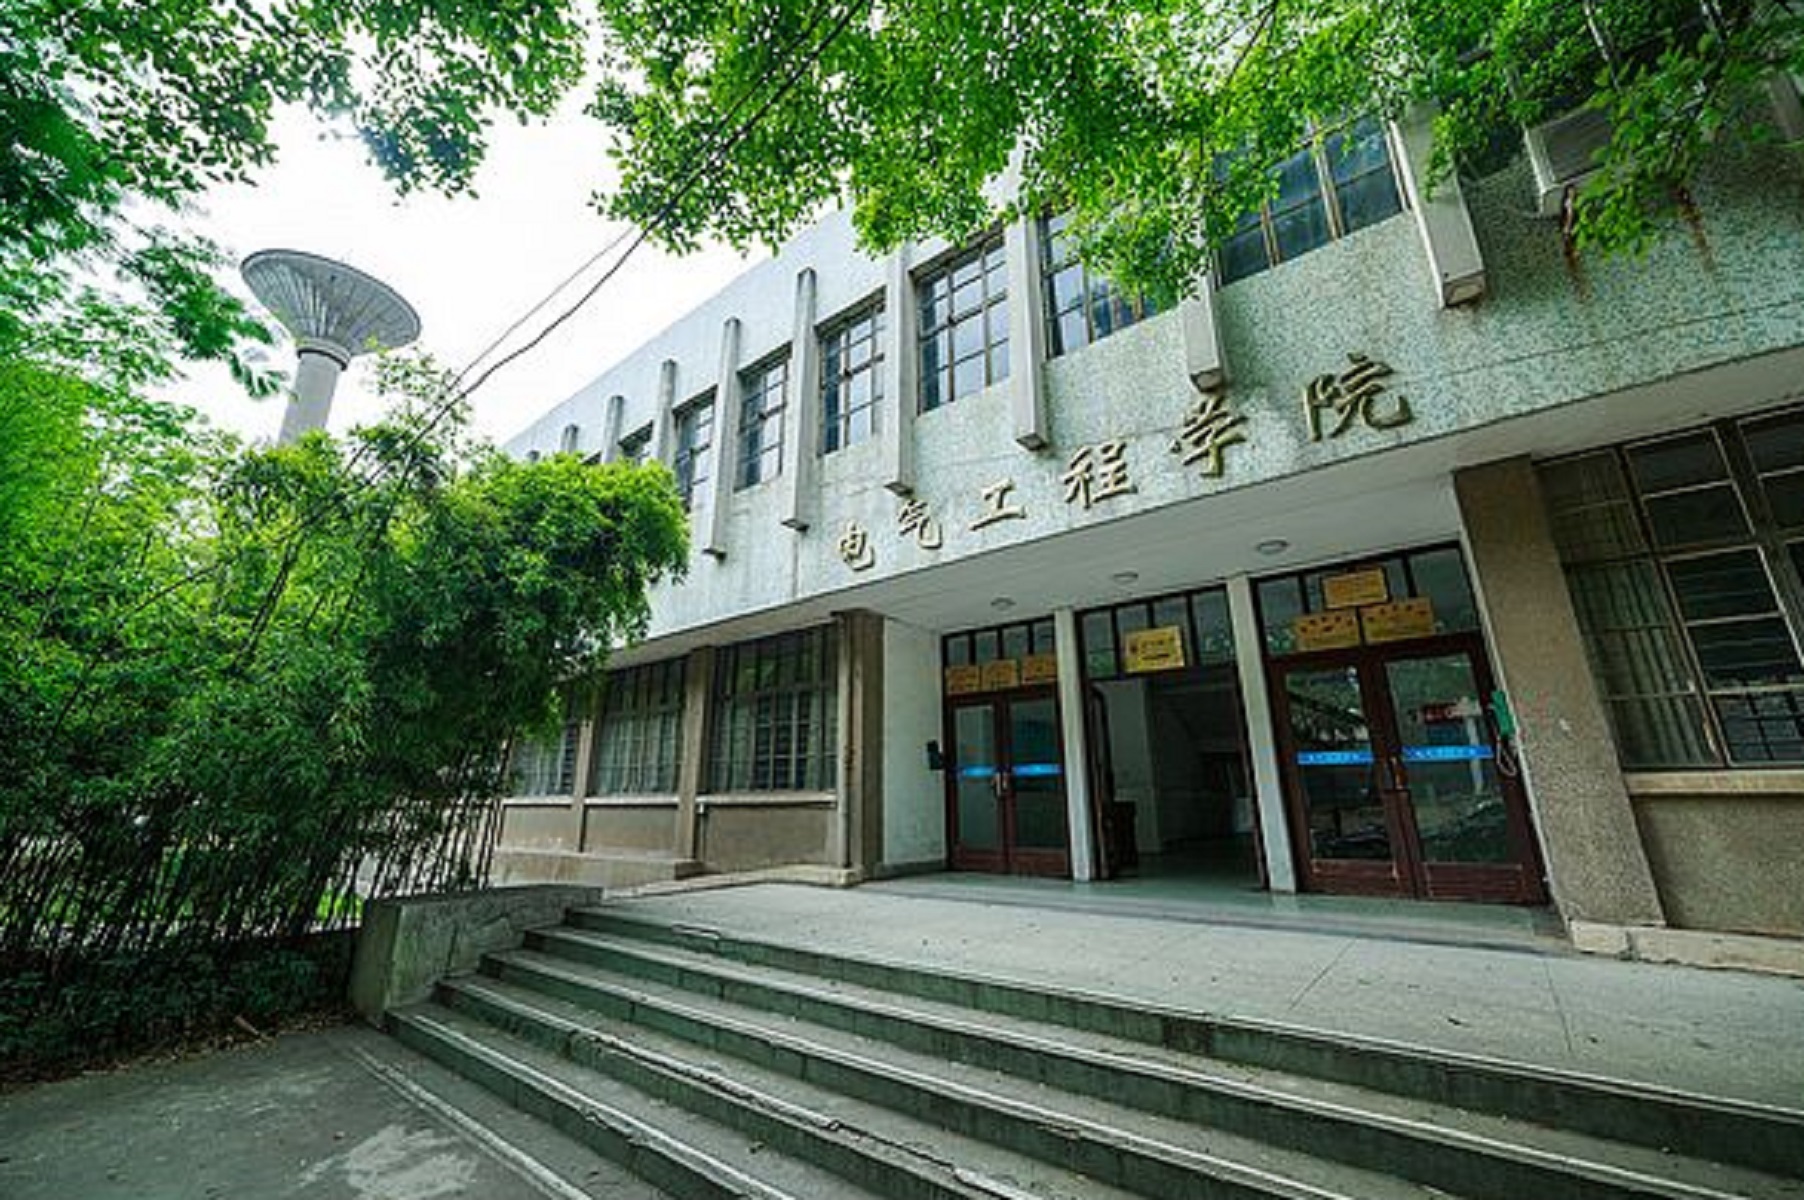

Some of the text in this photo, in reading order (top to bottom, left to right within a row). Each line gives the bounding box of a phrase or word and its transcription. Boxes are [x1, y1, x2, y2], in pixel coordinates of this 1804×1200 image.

[838, 354, 1412, 571] 电气工程学院
